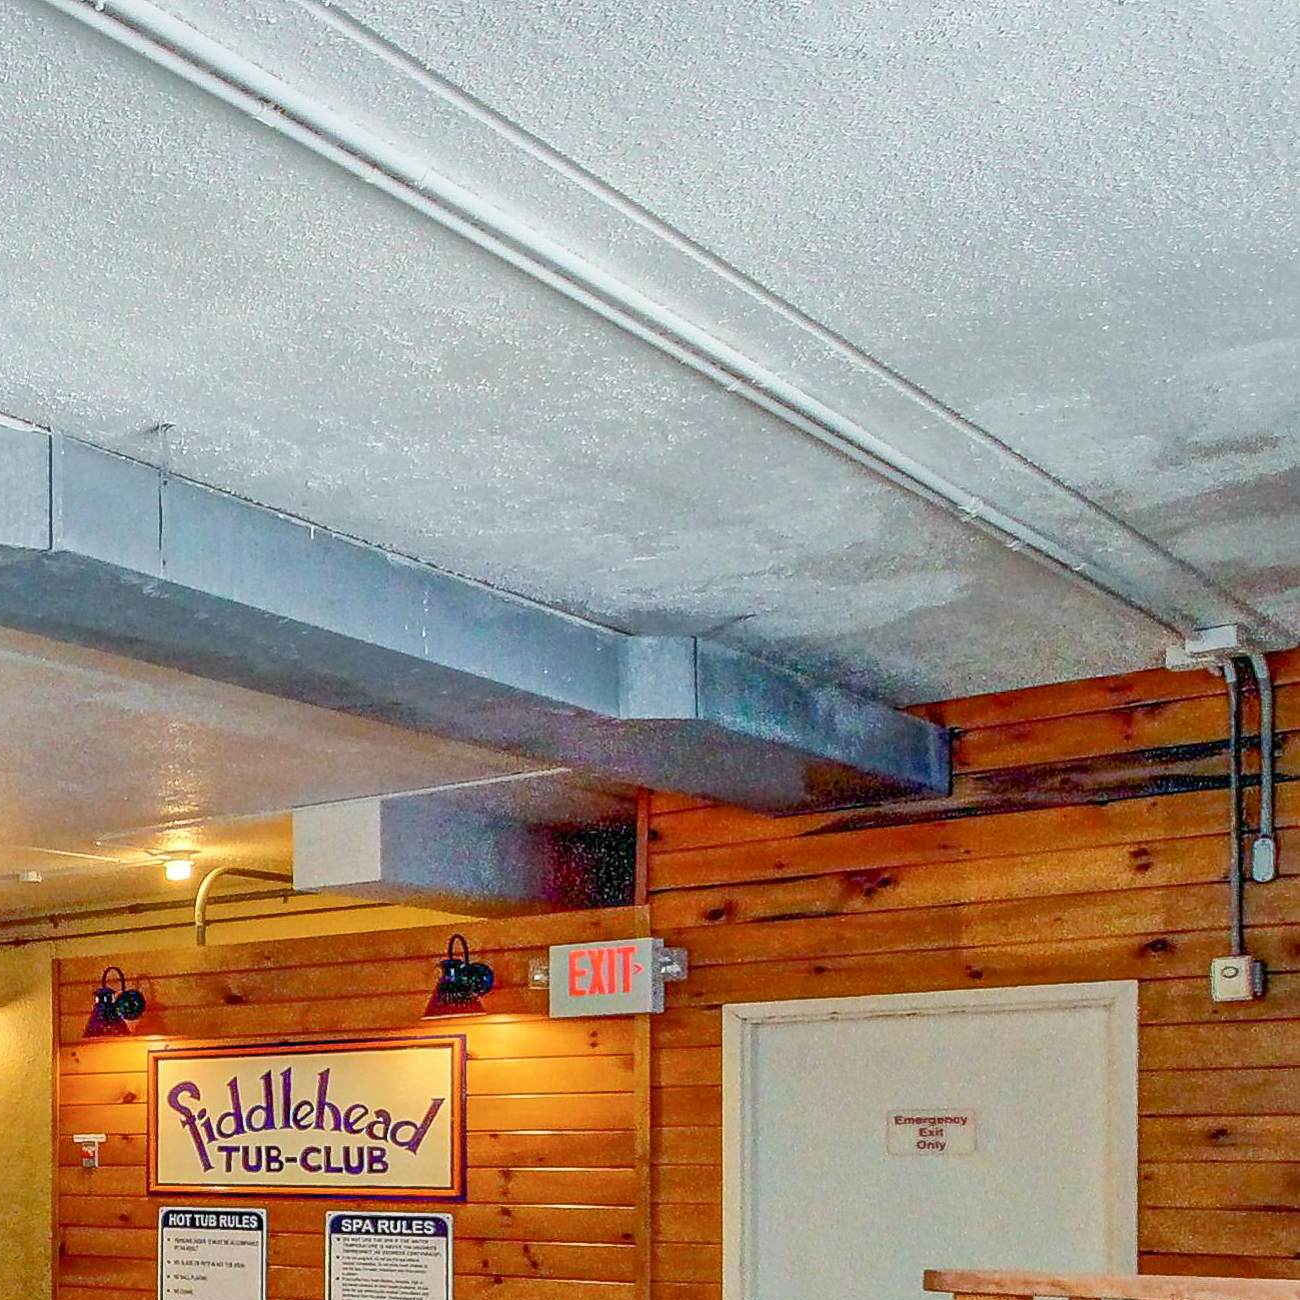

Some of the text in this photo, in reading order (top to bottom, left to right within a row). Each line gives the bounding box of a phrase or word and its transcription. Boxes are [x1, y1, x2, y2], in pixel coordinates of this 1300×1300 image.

[568, 946, 636, 997] EXIT
[894, 1115, 968, 1126] Emergency
[919, 1127, 944, 1138] Exit
[916, 1140, 946, 1151] Only
[217, 1144, 390, 1175] TUB-CLUB
[168, 1213, 258, 1229] HOT TUB RULES
[341, 1219, 436, 1235] SPA RULES
